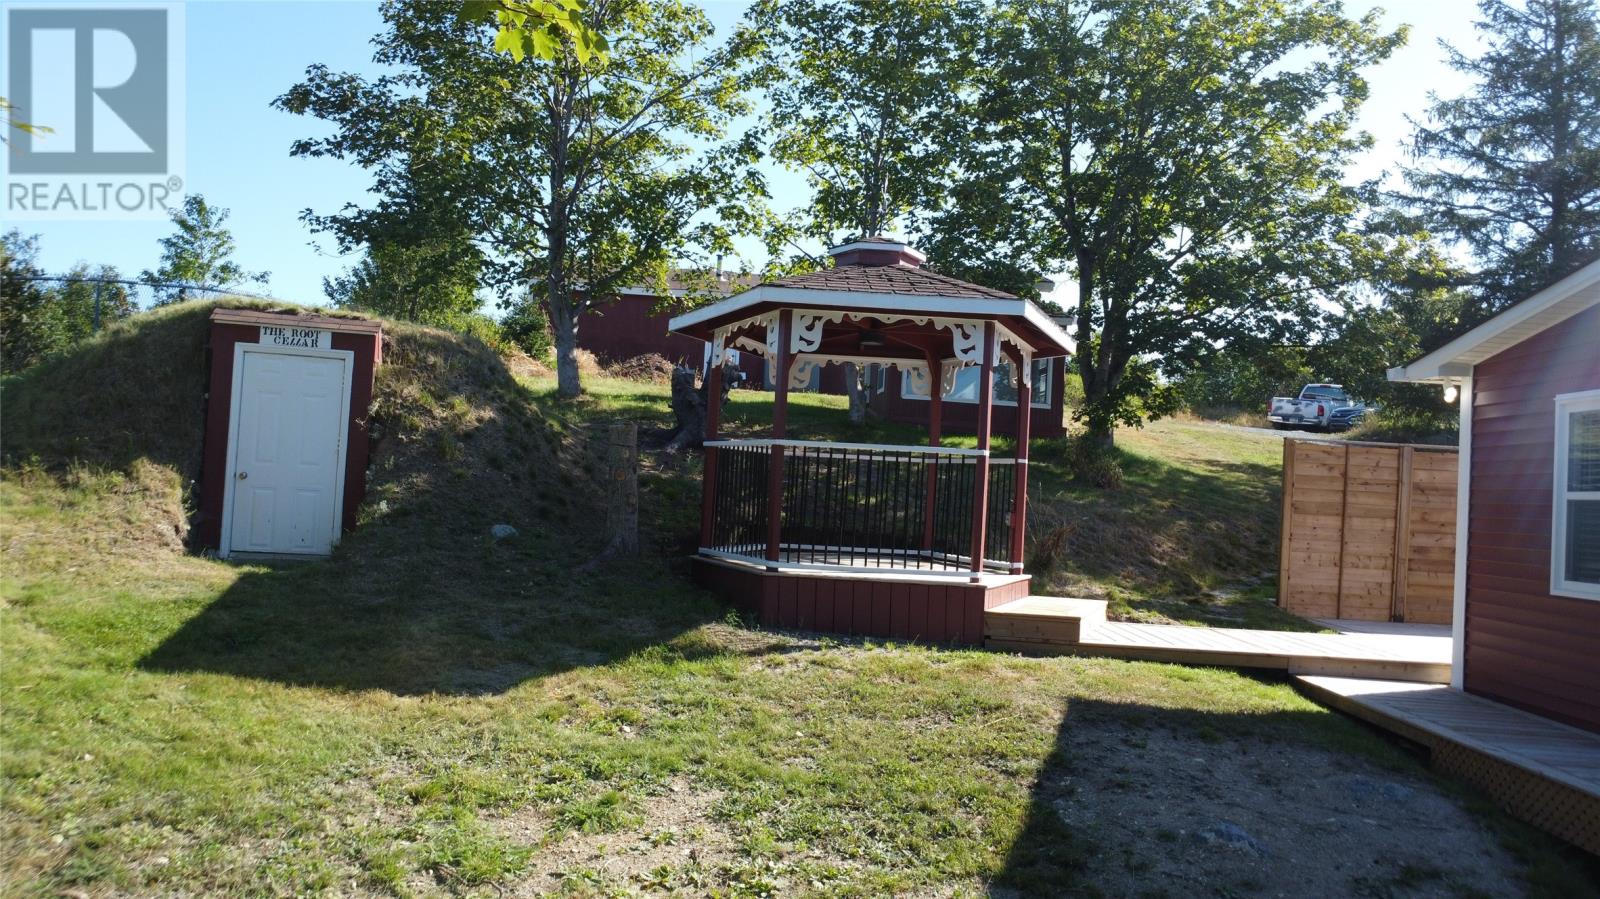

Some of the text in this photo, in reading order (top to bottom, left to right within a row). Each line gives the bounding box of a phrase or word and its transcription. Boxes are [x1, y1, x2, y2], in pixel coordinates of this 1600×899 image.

[262, 326, 320, 339] THE ROOT
[273, 336, 319, 348] CELLAR
